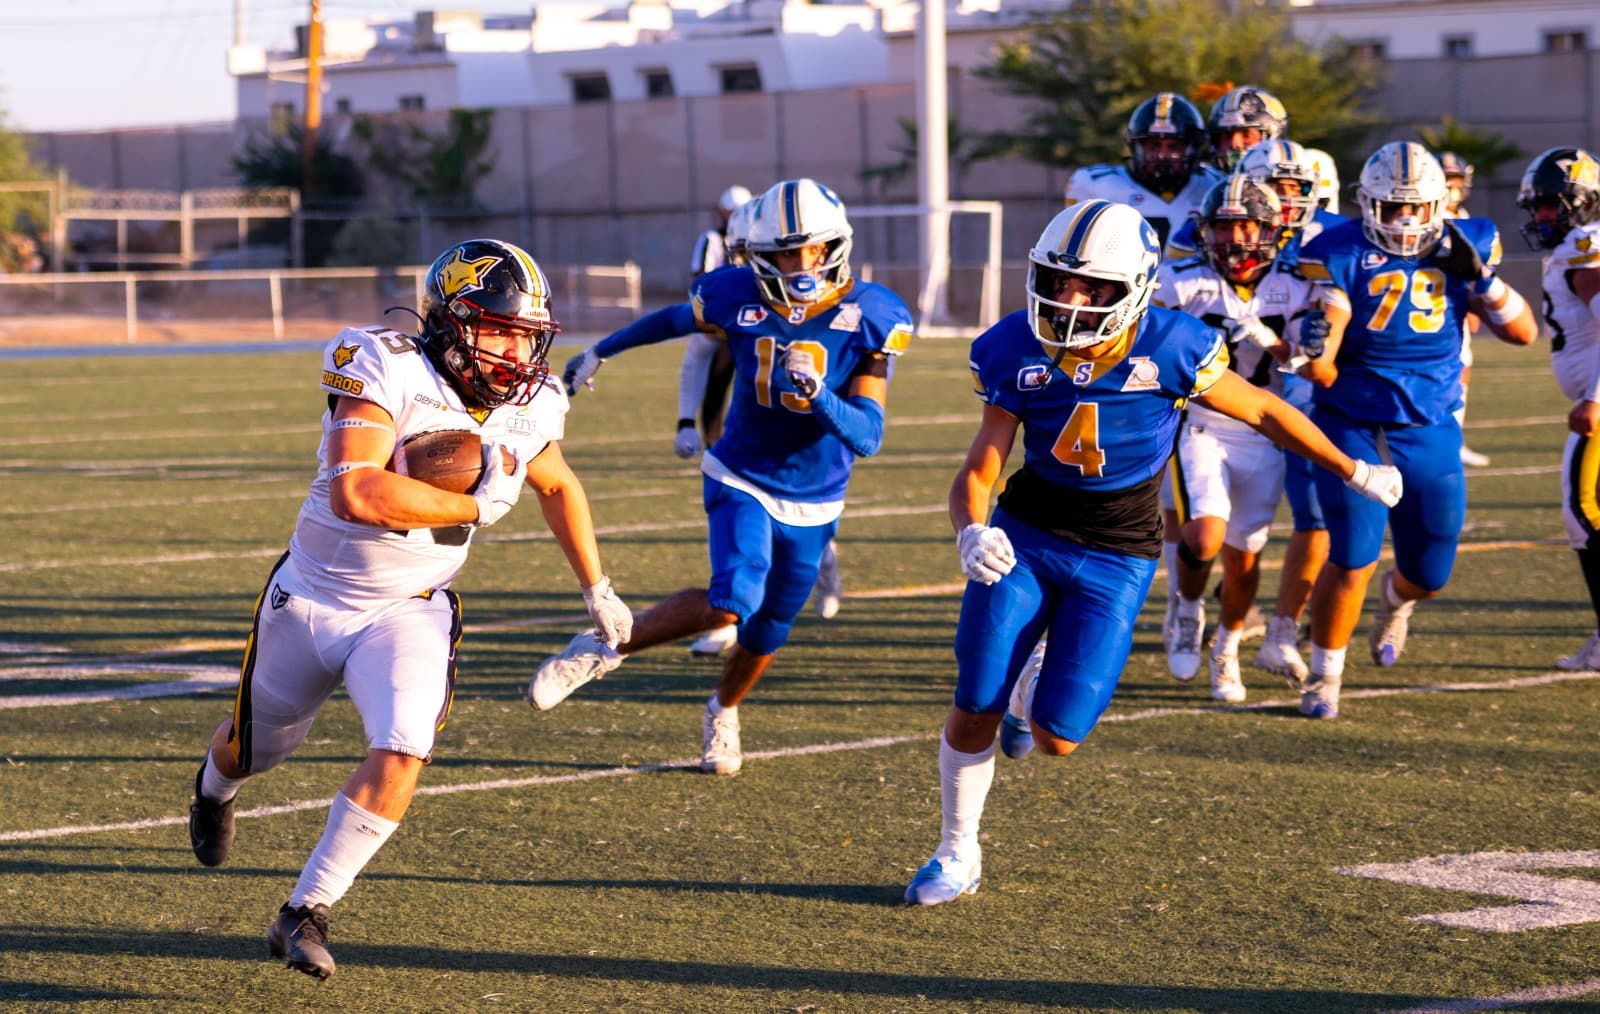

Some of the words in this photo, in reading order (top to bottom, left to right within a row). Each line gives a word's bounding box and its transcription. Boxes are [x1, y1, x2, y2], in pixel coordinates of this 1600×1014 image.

[788, 306, 807, 323] S
[1367, 268, 1447, 333] 79
[1073, 362, 1095, 385] S
[1051, 402, 1105, 477] 4
